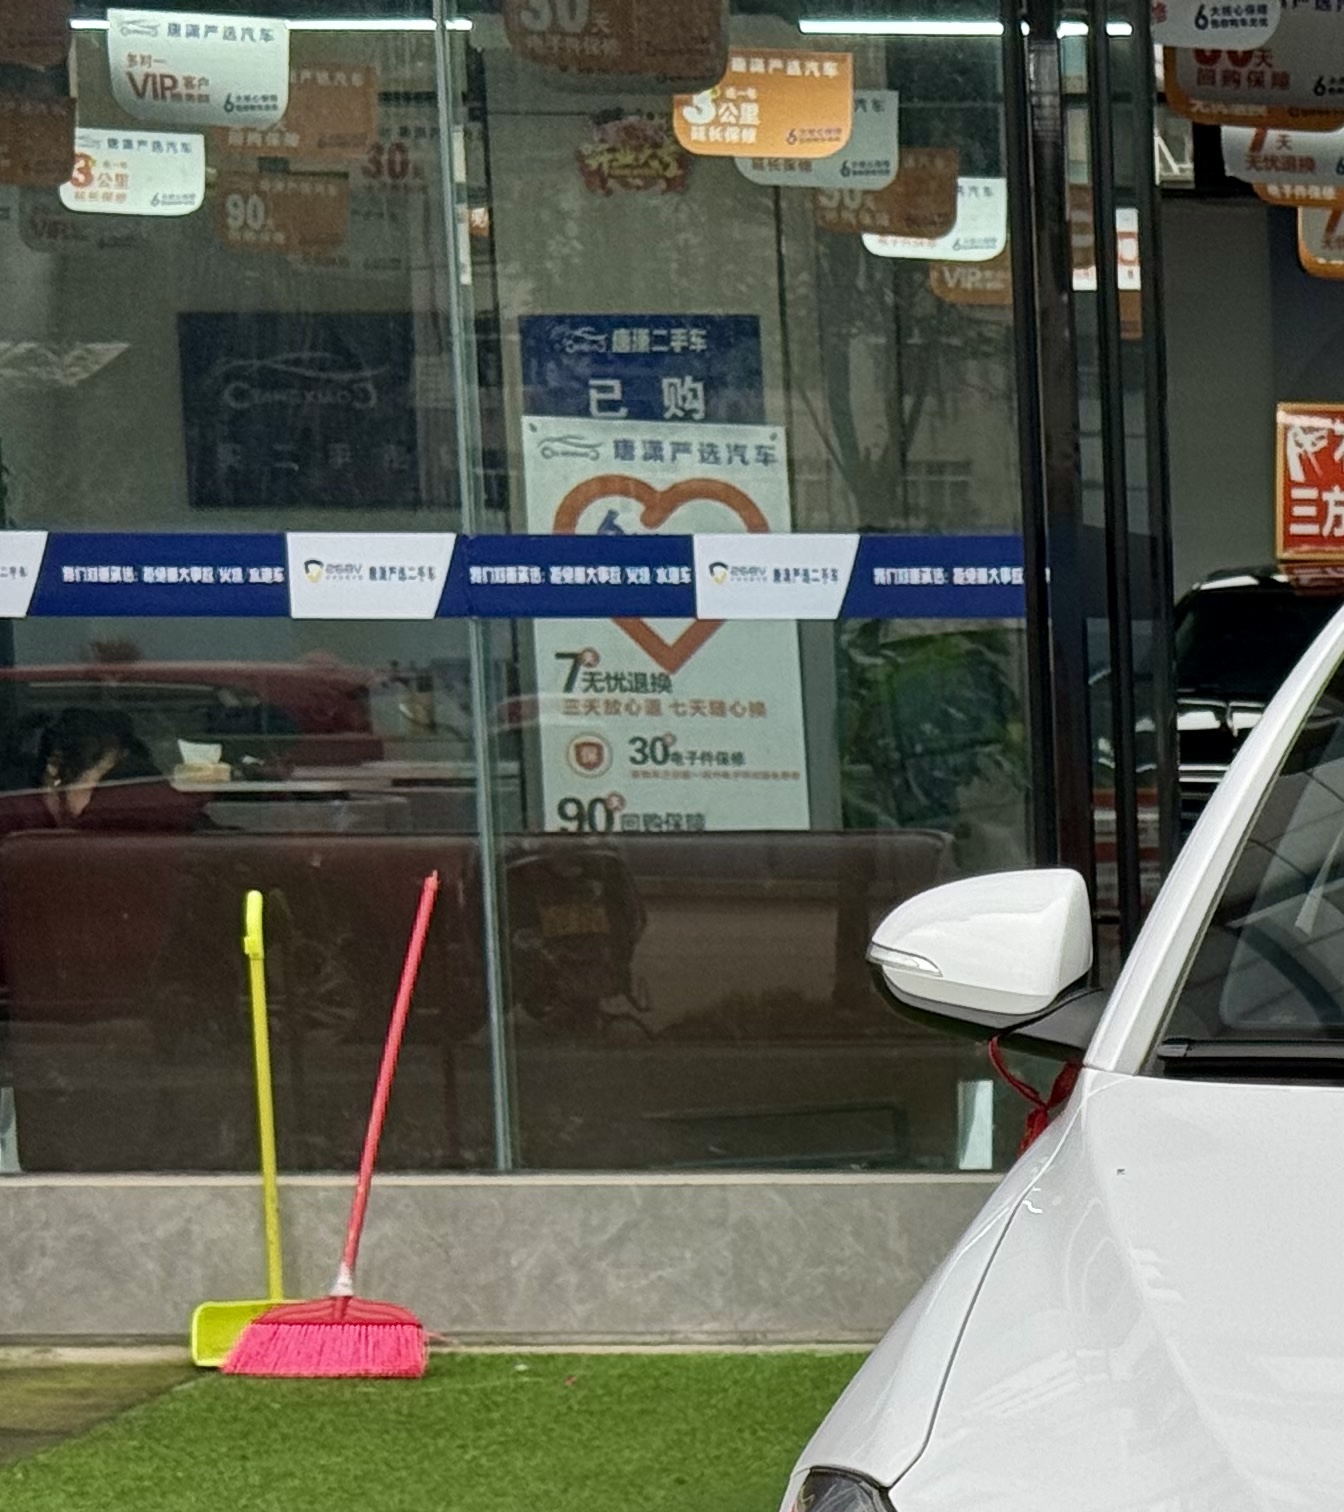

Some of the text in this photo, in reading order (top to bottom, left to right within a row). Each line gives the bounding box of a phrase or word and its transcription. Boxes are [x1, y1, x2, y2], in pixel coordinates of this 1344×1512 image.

[1195, 4, 1208, 30] 6
[126, 71, 179, 100] VIP
[1196, 71, 1291, 91] 回购保障
[1313, 76, 1327, 96] 6
[719, 103, 760, 125] 公里
[70, 153, 95, 187] 3
[1246, 154, 1317, 174] 无忧退换
[614, 438, 780, 468] 唐潇严选汽车
[555, 652, 673, 695] 7 无忧退换
[628, 736, 746, 767] 30 电子件保修
[557, 797, 706, 833] 90 回购保障
